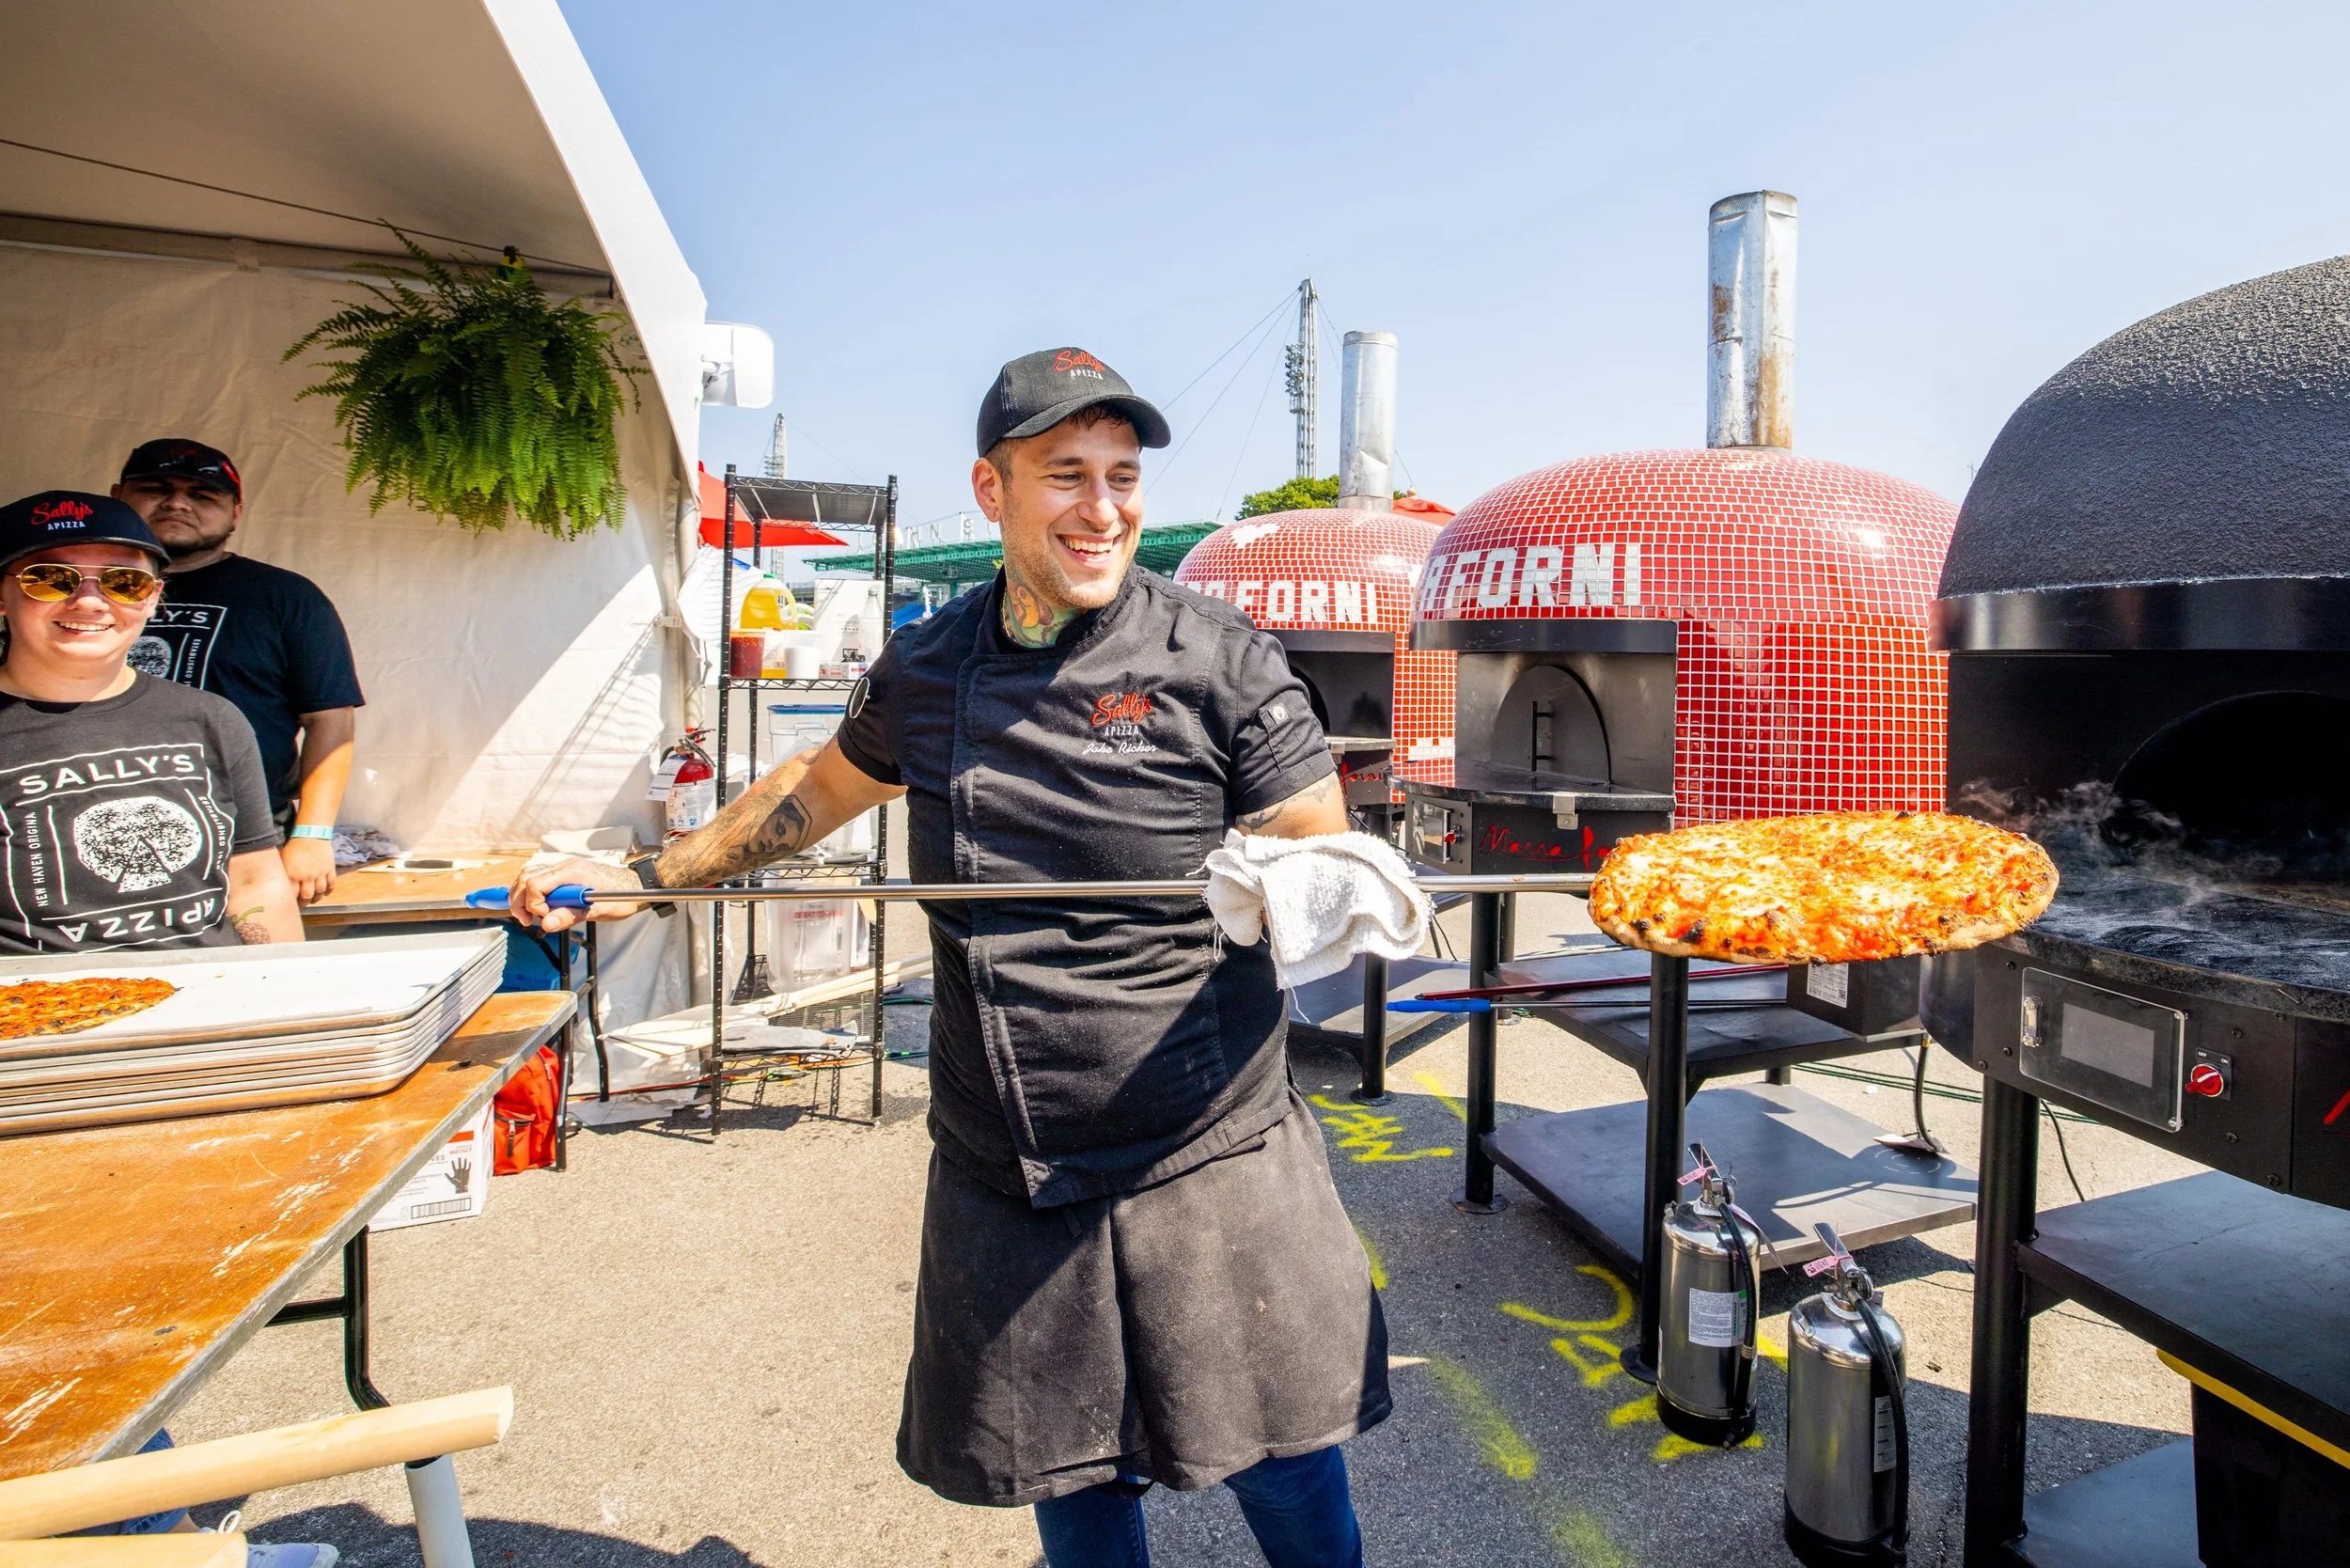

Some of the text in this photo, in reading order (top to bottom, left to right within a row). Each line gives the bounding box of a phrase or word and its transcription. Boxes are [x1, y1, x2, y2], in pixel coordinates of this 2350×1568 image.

[1070, 368, 1104, 381] APIZZA
[30, 500, 93, 525] Sally's
[47, 521, 86, 531] APIZZA
[1444, 543, 1639, 607] FORNI
[149, 610, 209, 623] LY'S
[184, 638, 202, 679] ESTABLISHED
[1090, 692, 1152, 727] Sally's
[1104, 725, 1139, 736] APIZZA
[19, 754, 196, 794] SALLY'S
[197, 795, 227, 847] ESTABLISHED
[25, 811, 49, 907] NEW HAVEN ORIGINA
[57, 897, 215, 943] APIZZA
